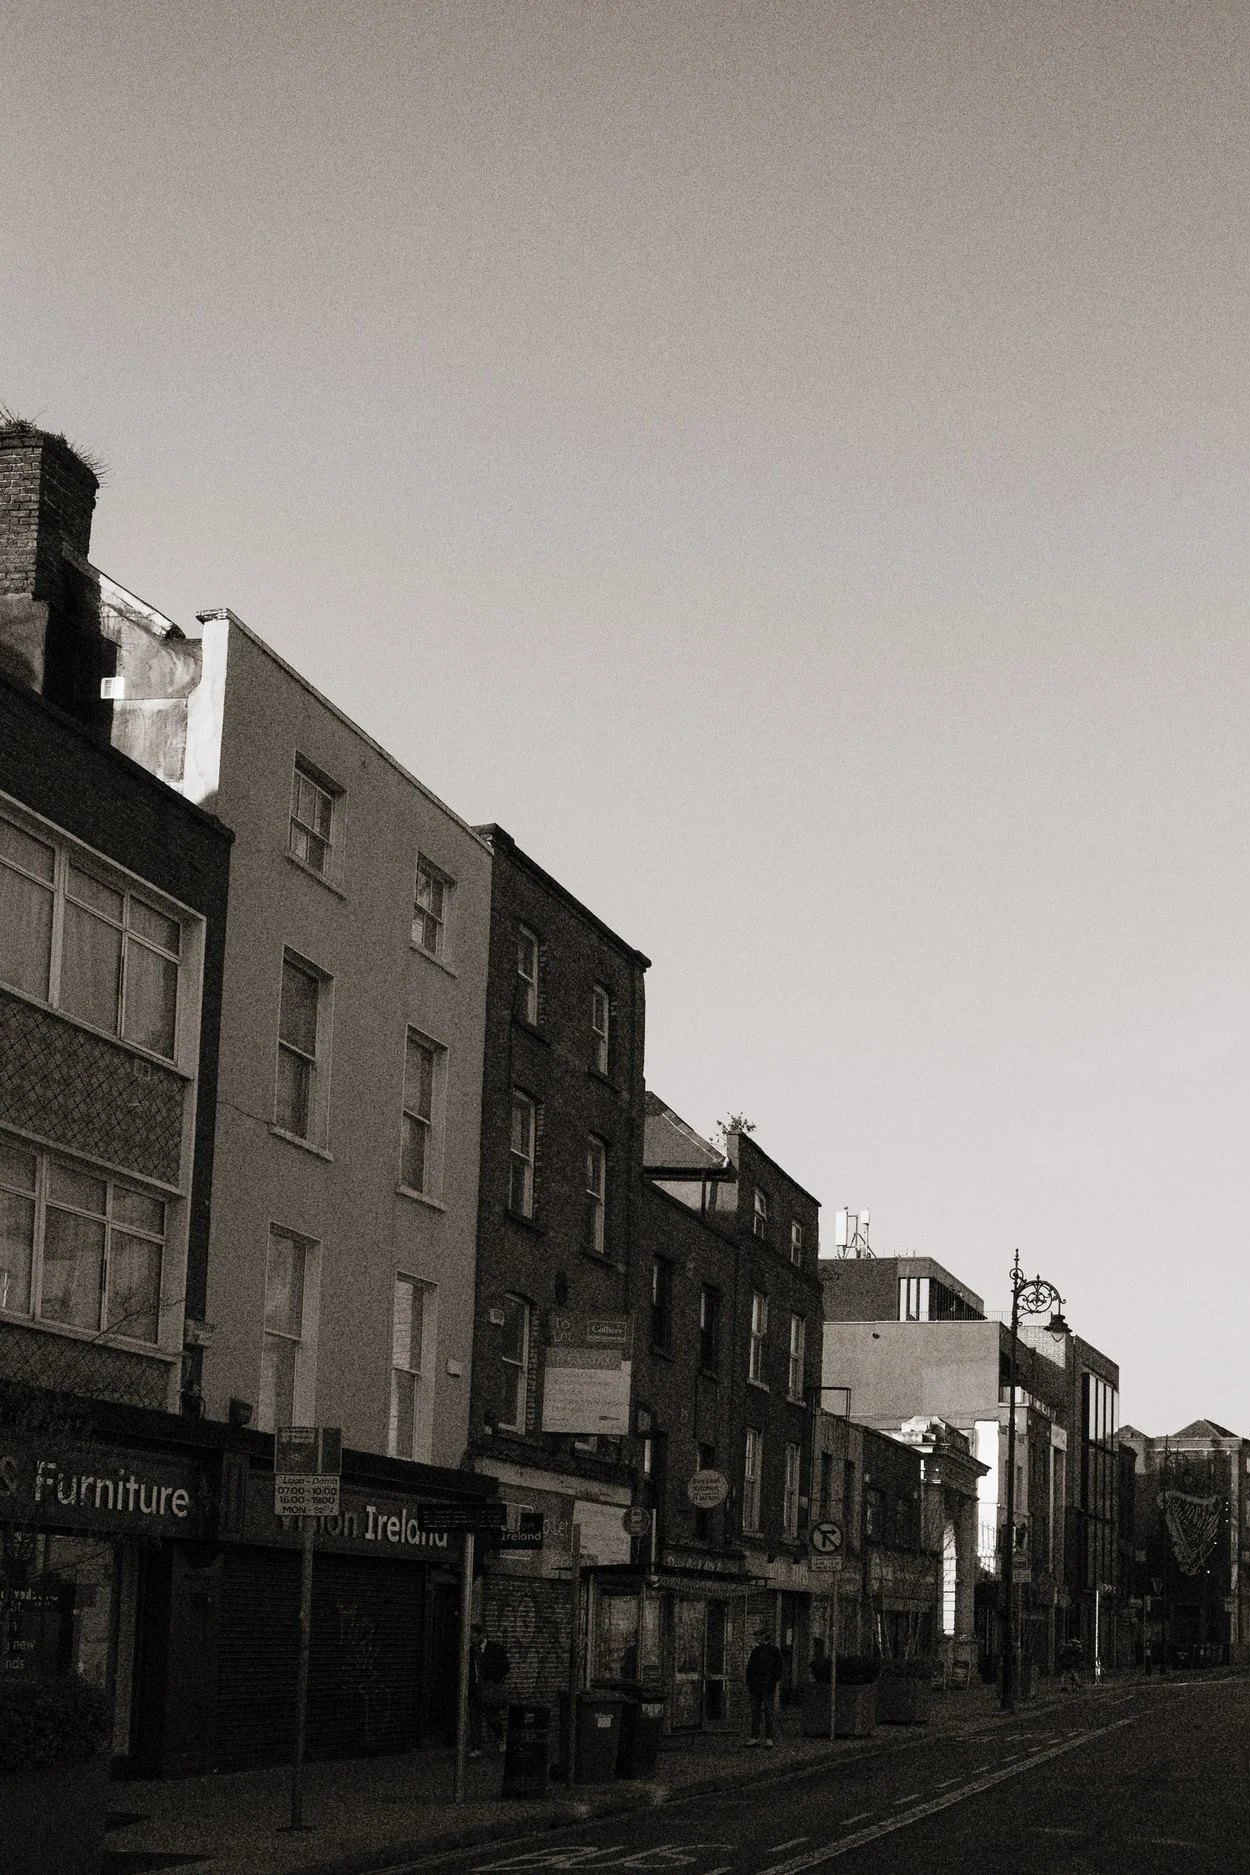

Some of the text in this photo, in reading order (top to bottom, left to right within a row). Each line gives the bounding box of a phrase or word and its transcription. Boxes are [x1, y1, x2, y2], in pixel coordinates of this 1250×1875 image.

[35, 1461, 190, 1518] Furniture
[282, 1505, 306, 1514] MON
[469, 1844, 736, 1872] BUS
